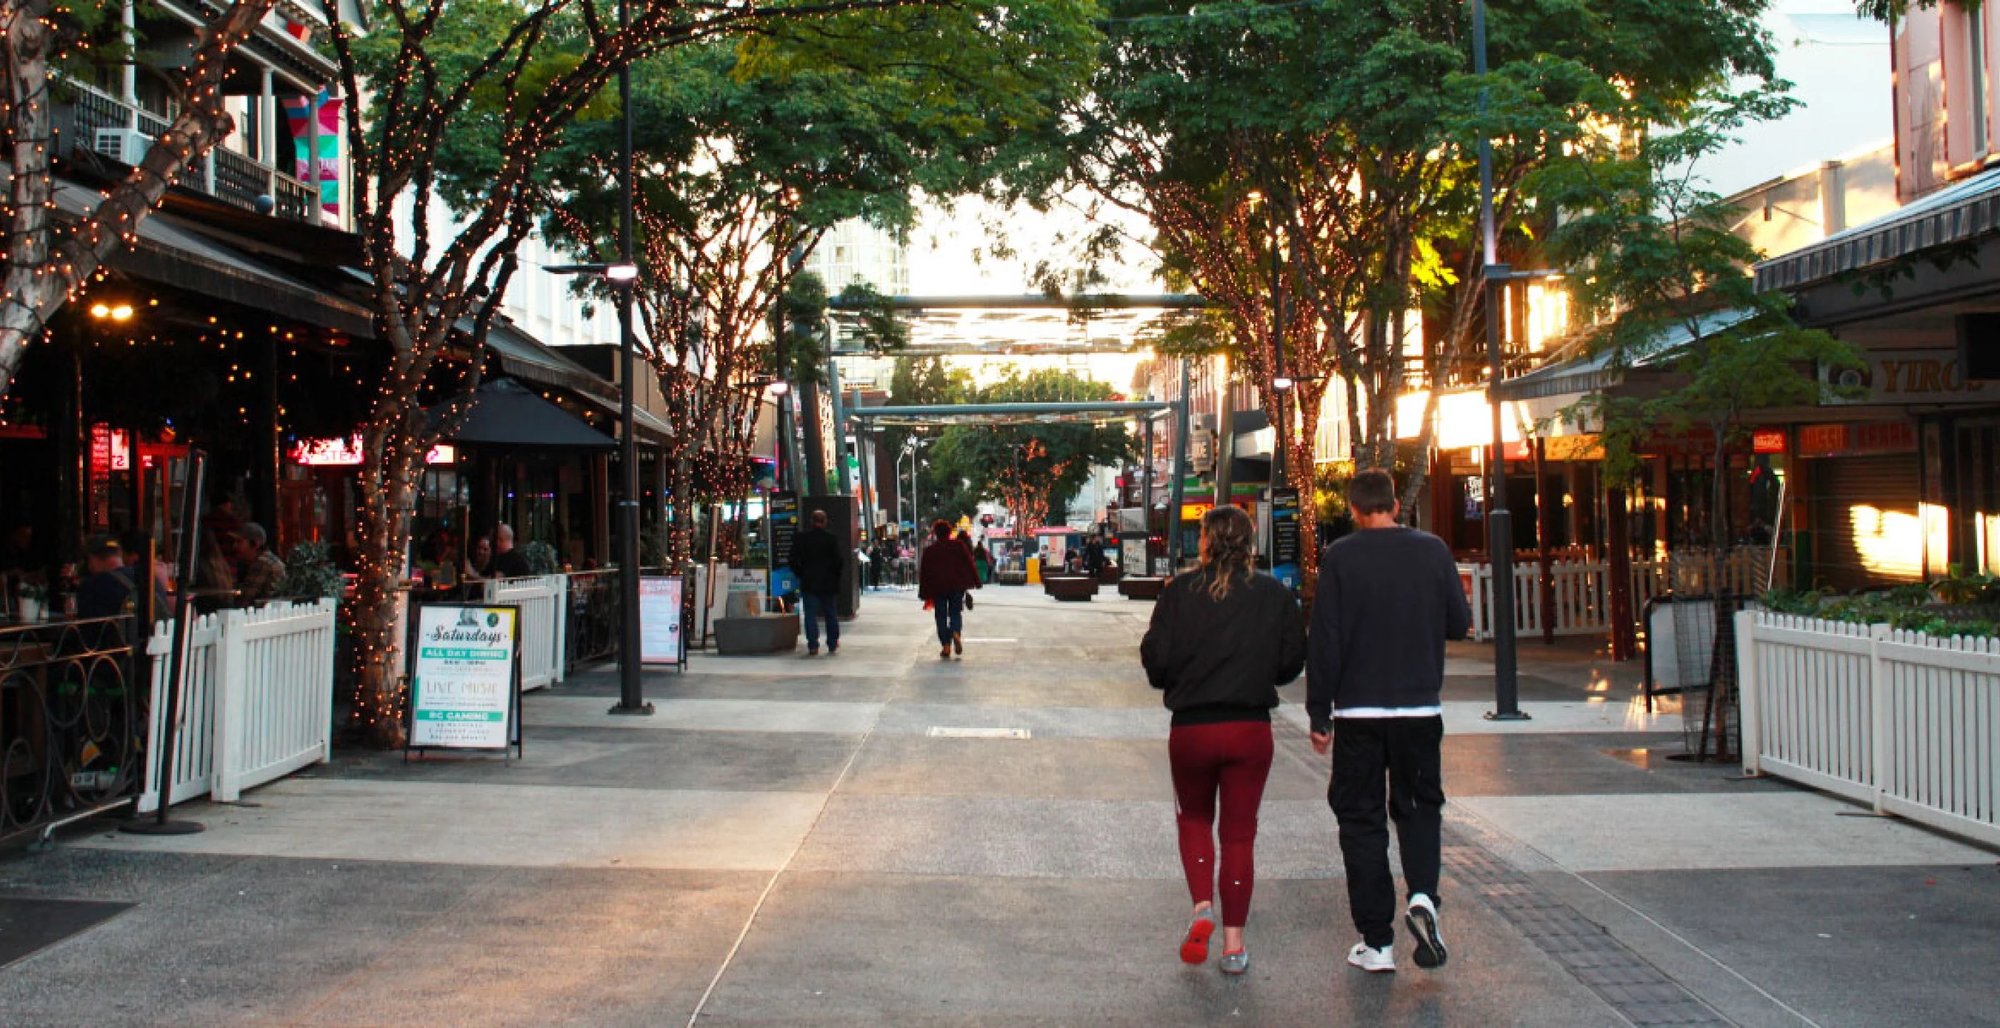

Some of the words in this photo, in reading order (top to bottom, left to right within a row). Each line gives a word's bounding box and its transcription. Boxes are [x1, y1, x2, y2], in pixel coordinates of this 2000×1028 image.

[1880, 358, 1986, 393] YIRO
[430, 624, 501, 647] Saturdays
[425, 648, 444, 658] ALL
[446, 649, 467, 658] DAY
[426, 680, 454, 694] LIVE
[461, 681, 497, 696] MUSIC
